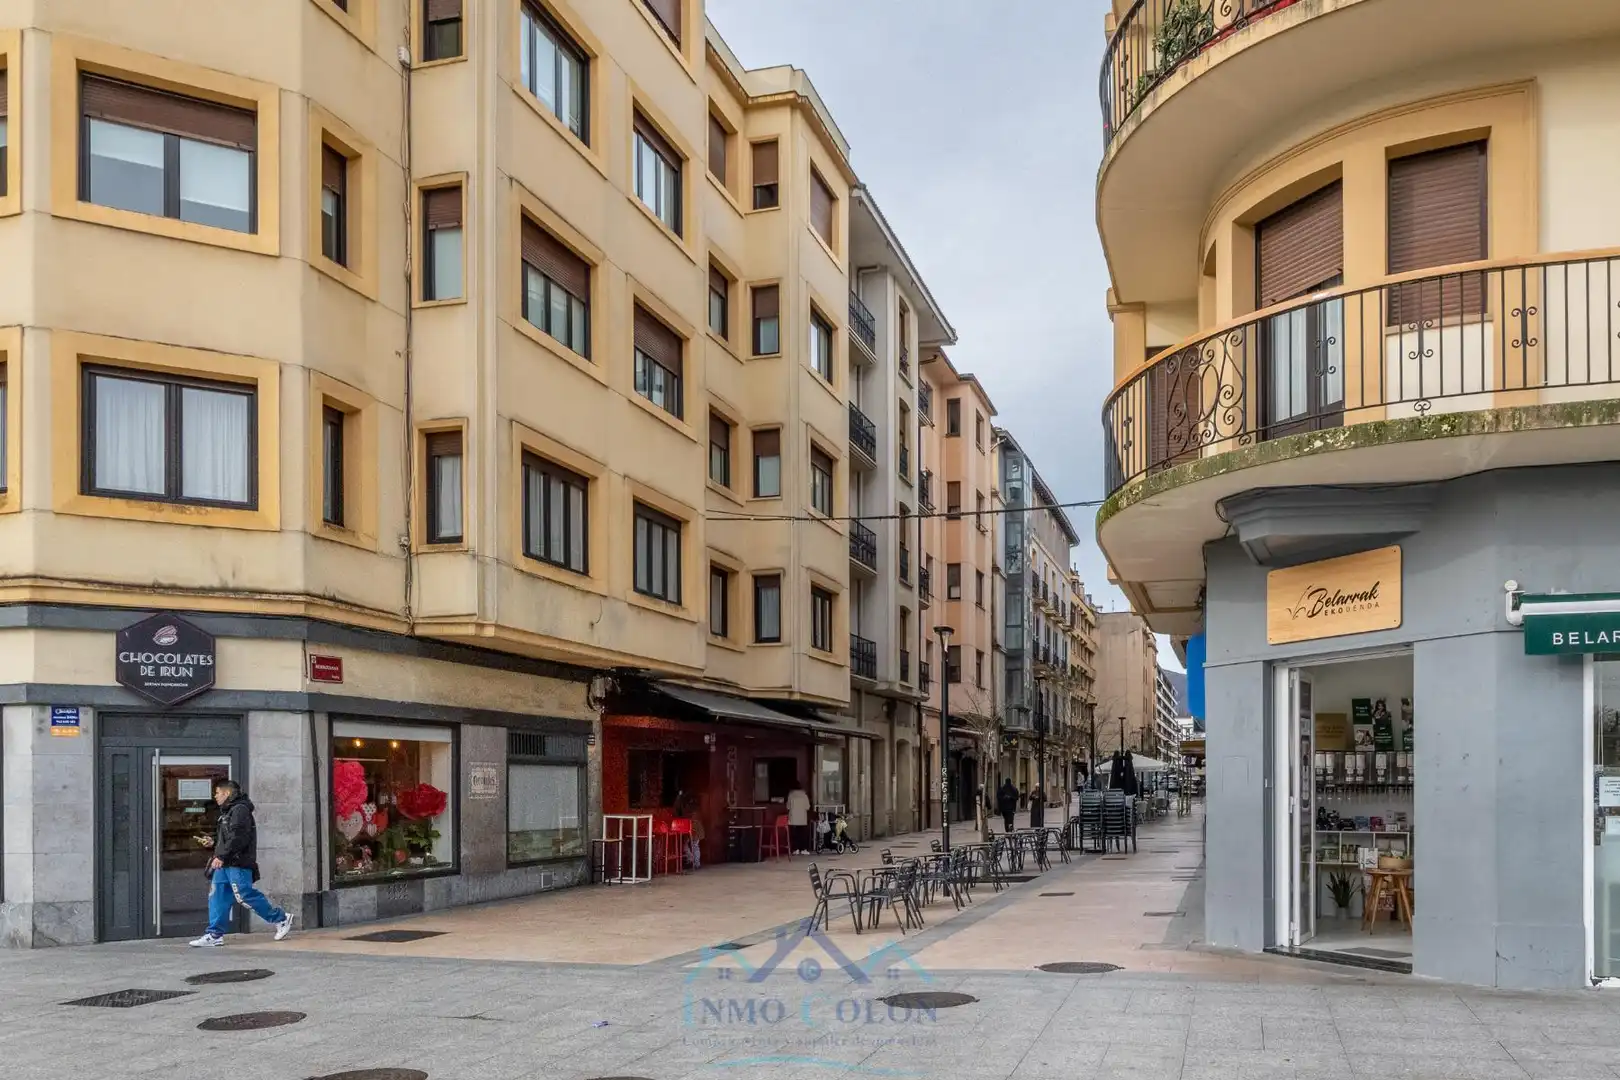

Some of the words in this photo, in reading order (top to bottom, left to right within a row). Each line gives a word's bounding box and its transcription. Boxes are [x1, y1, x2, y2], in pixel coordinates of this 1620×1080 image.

[1307, 580, 1380, 619] Belarrak
[1324, 601, 1381, 617] EKODENDA
[119, 651, 213, 666] CHOCOLATES
[140, 665, 156, 677] DE
[160, 665, 194, 678] IRUN
